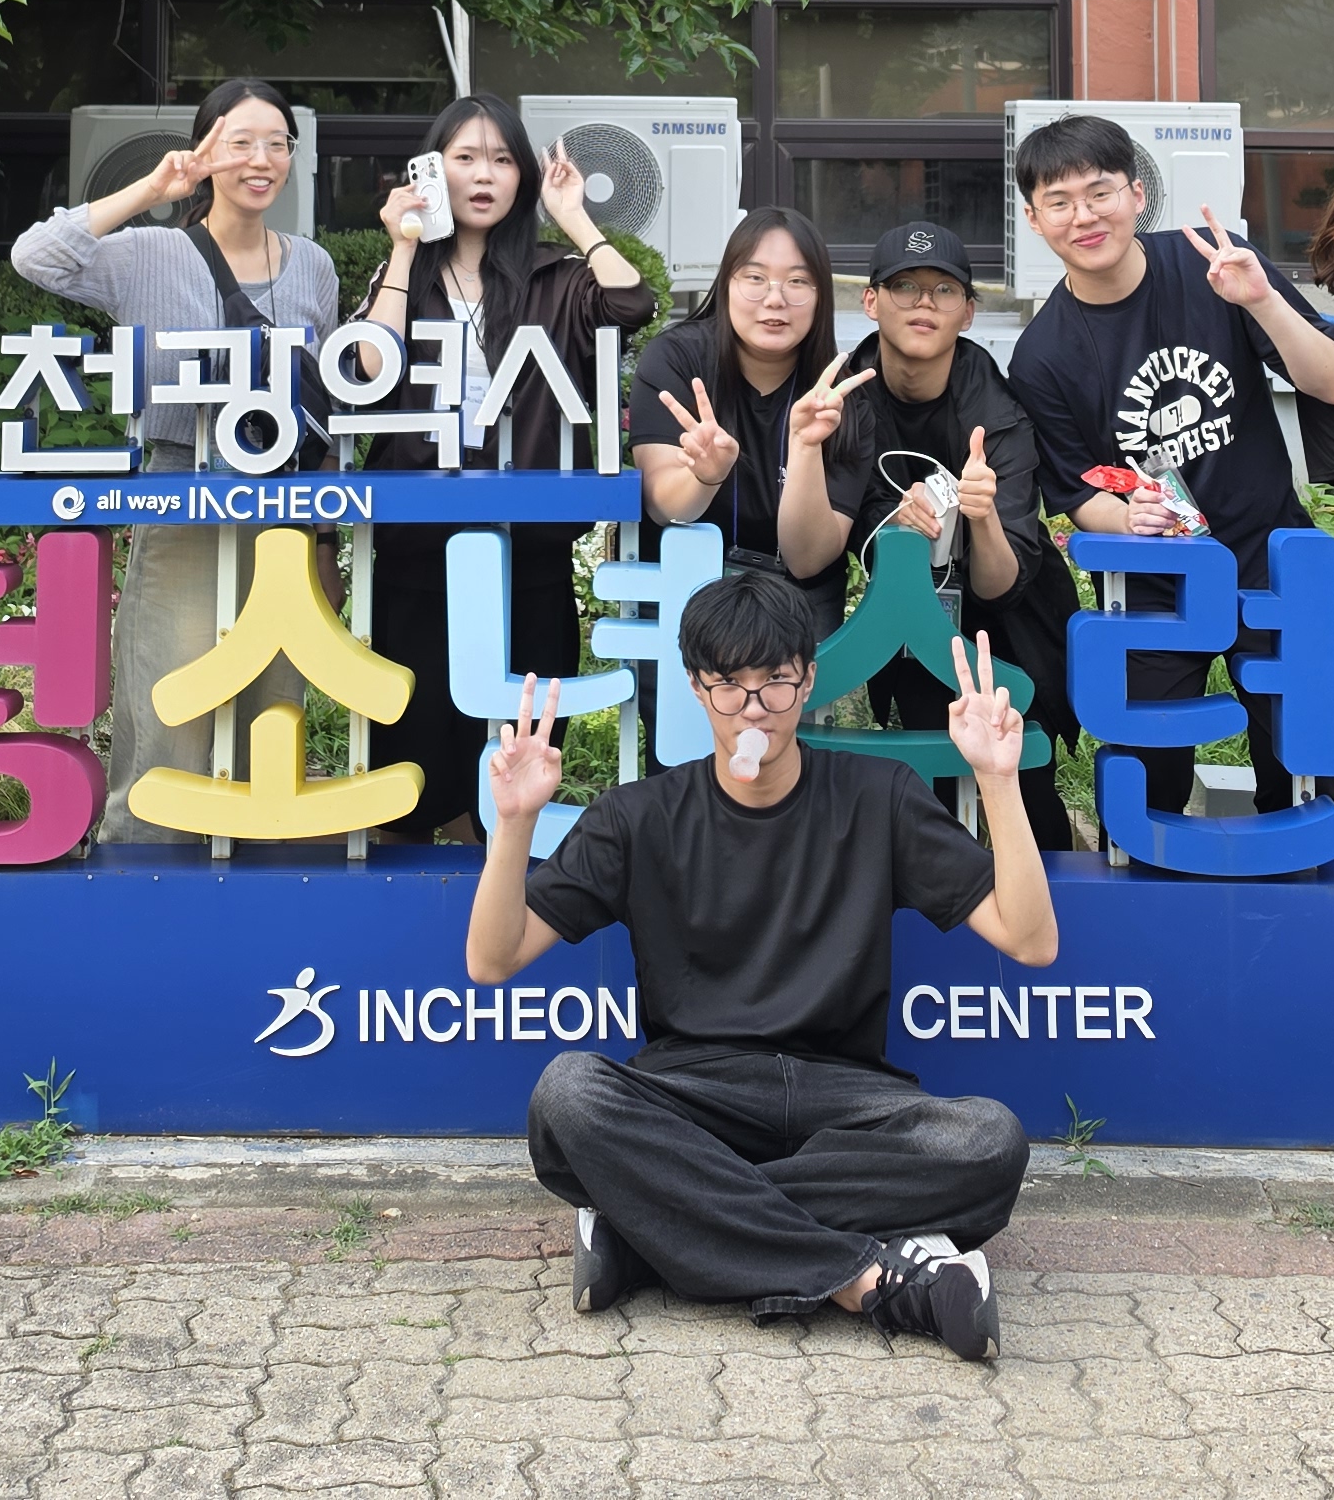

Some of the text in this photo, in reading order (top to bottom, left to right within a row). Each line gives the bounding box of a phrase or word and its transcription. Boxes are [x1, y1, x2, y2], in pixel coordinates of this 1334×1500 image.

[651, 122, 727, 135] SAMSUNG
[1154, 127, 1232, 141] SAMSUNG
[1115, 345, 1236, 452] NANTUCKET
[96, 485, 373, 521] all ways INCHEON
[358, 984, 1157, 1043] INCHEON CENTER
